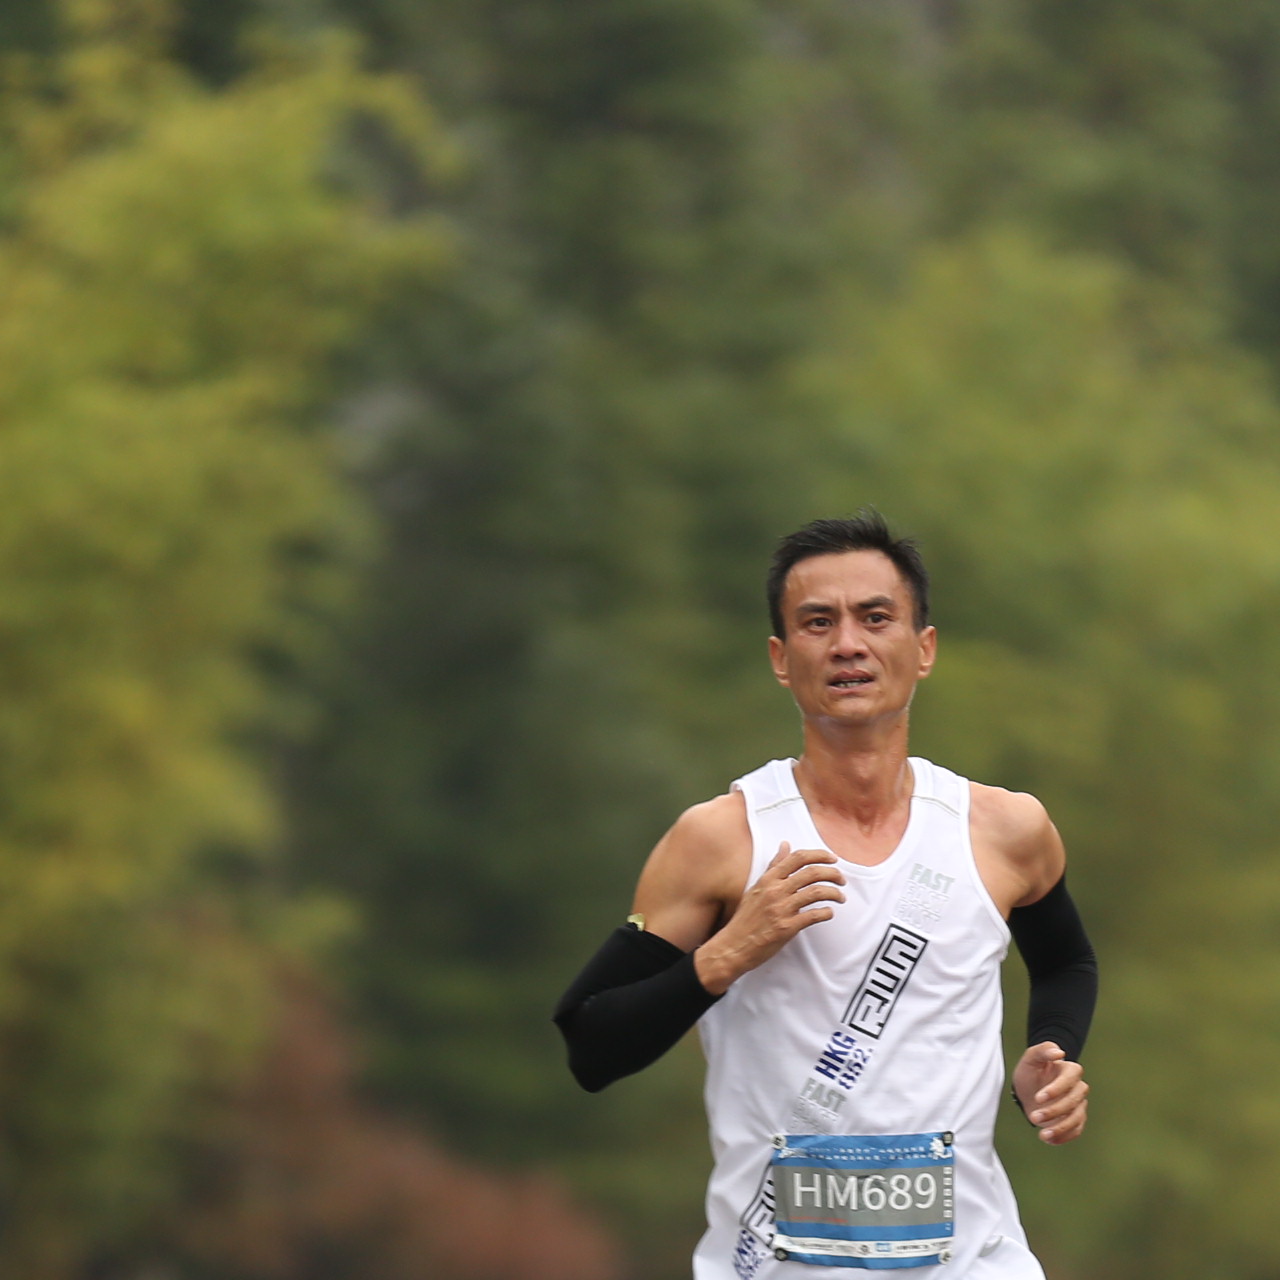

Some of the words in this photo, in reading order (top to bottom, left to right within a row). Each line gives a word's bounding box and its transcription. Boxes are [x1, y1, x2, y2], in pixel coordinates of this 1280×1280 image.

[910, 863, 956, 894] FAST
[814, 1031, 857, 1080] HKG
[800, 1077, 847, 1113] FAST
[793, 1172, 937, 1211] HM689
